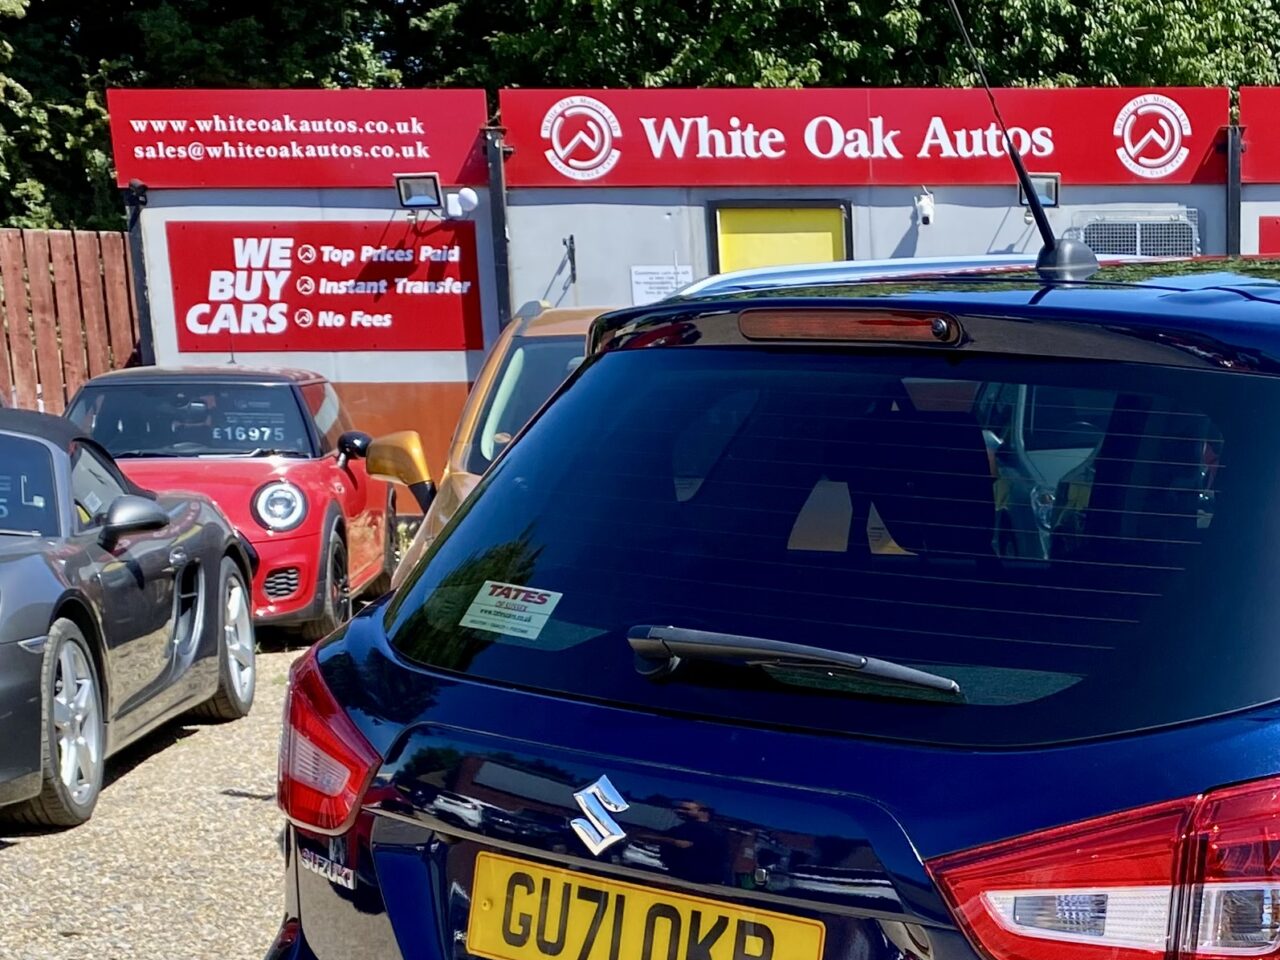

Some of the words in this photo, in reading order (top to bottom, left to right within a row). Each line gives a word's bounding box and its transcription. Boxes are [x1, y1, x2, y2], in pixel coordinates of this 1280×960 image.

[129, 115, 425, 135] www.whiteoakautos.co.uk
[639, 116, 786, 158] White
[804, 115, 904, 158] Oak
[917, 116, 1055, 158] Autos
[134, 141, 430, 160] sales@whiteoakautos.co.uk
[232, 237, 294, 269] WE
[320, 246, 355, 266] Top
[360, 246, 414, 262] Prices
[418, 246, 460, 262] Paid
[208, 270, 292, 301] BUY
[318, 278, 388, 294] Instant
[394, 278, 471, 294] Transfer
[185, 303, 288, 335] CARS
[317, 311, 345, 328] No
[350, 311, 393, 328] Fees
[212, 426, 285, 441] £16975
[488, 584, 551, 605] TATES
[301, 848, 355, 890] SUZUKI
